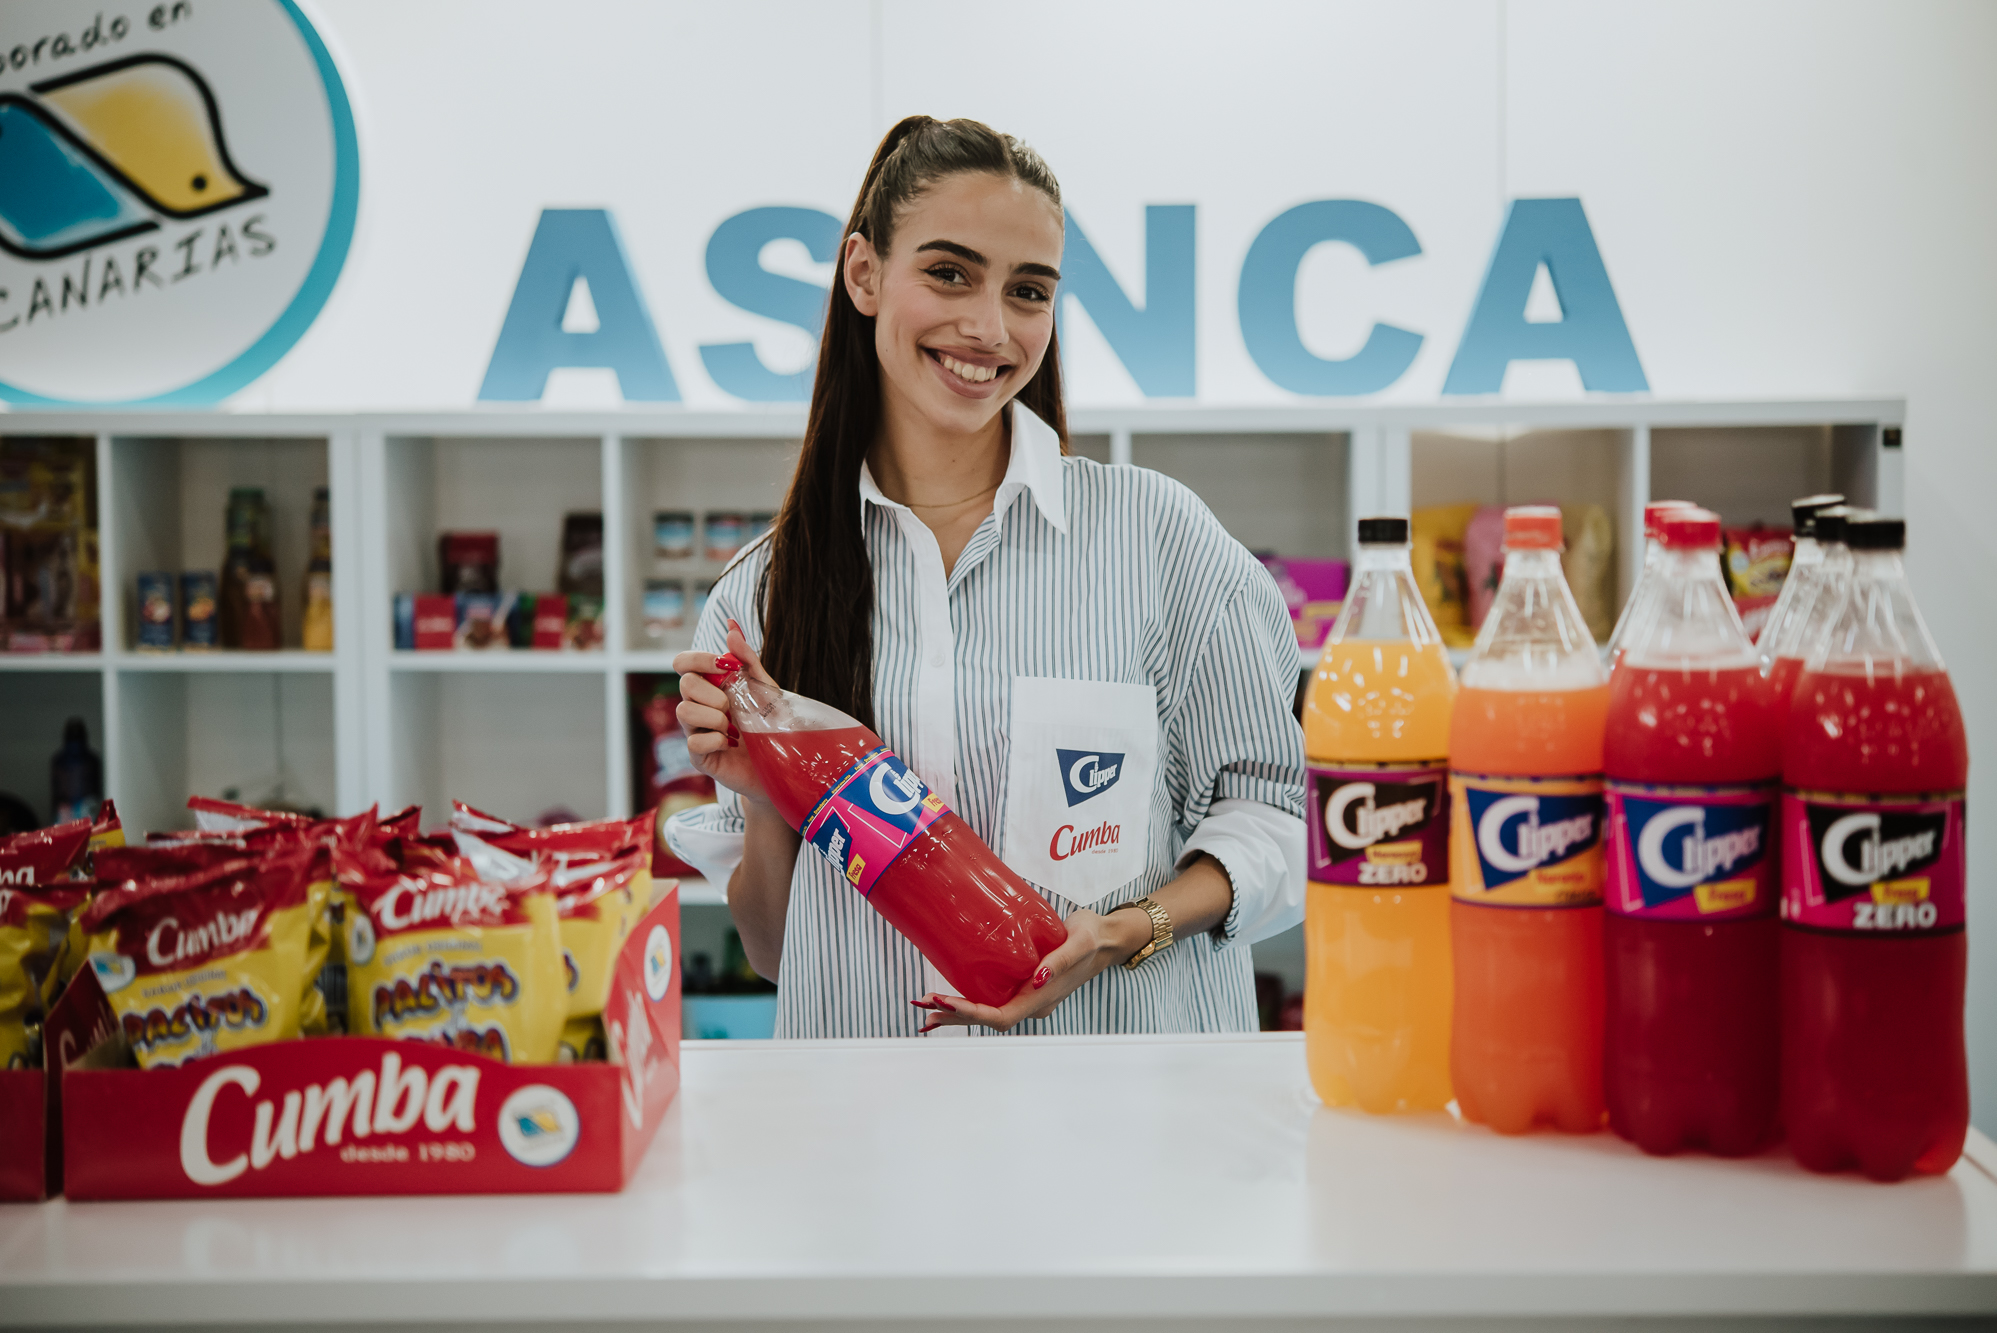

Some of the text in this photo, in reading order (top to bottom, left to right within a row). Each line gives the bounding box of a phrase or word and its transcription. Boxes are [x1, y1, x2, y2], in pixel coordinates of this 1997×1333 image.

[0, 0, 192, 75] orado en
[478, 196, 1651, 402] ASNCA
[1069, 755, 1118, 794] Clipper
[1049, 821, 1120, 861] Cumba
[1325, 782, 1427, 849] Clipper
[1478, 796, 1594, 872] Clipper
[1638, 806, 1762, 889] Clipper
[1821, 813, 1937, 886] Clipper
[1357, 862, 1428, 884] ZERO
[1852, 902, 1938, 929] ZERO
[180, 1050, 482, 1186] Cumba
[340, 1140, 477, 1163] desde 1980
